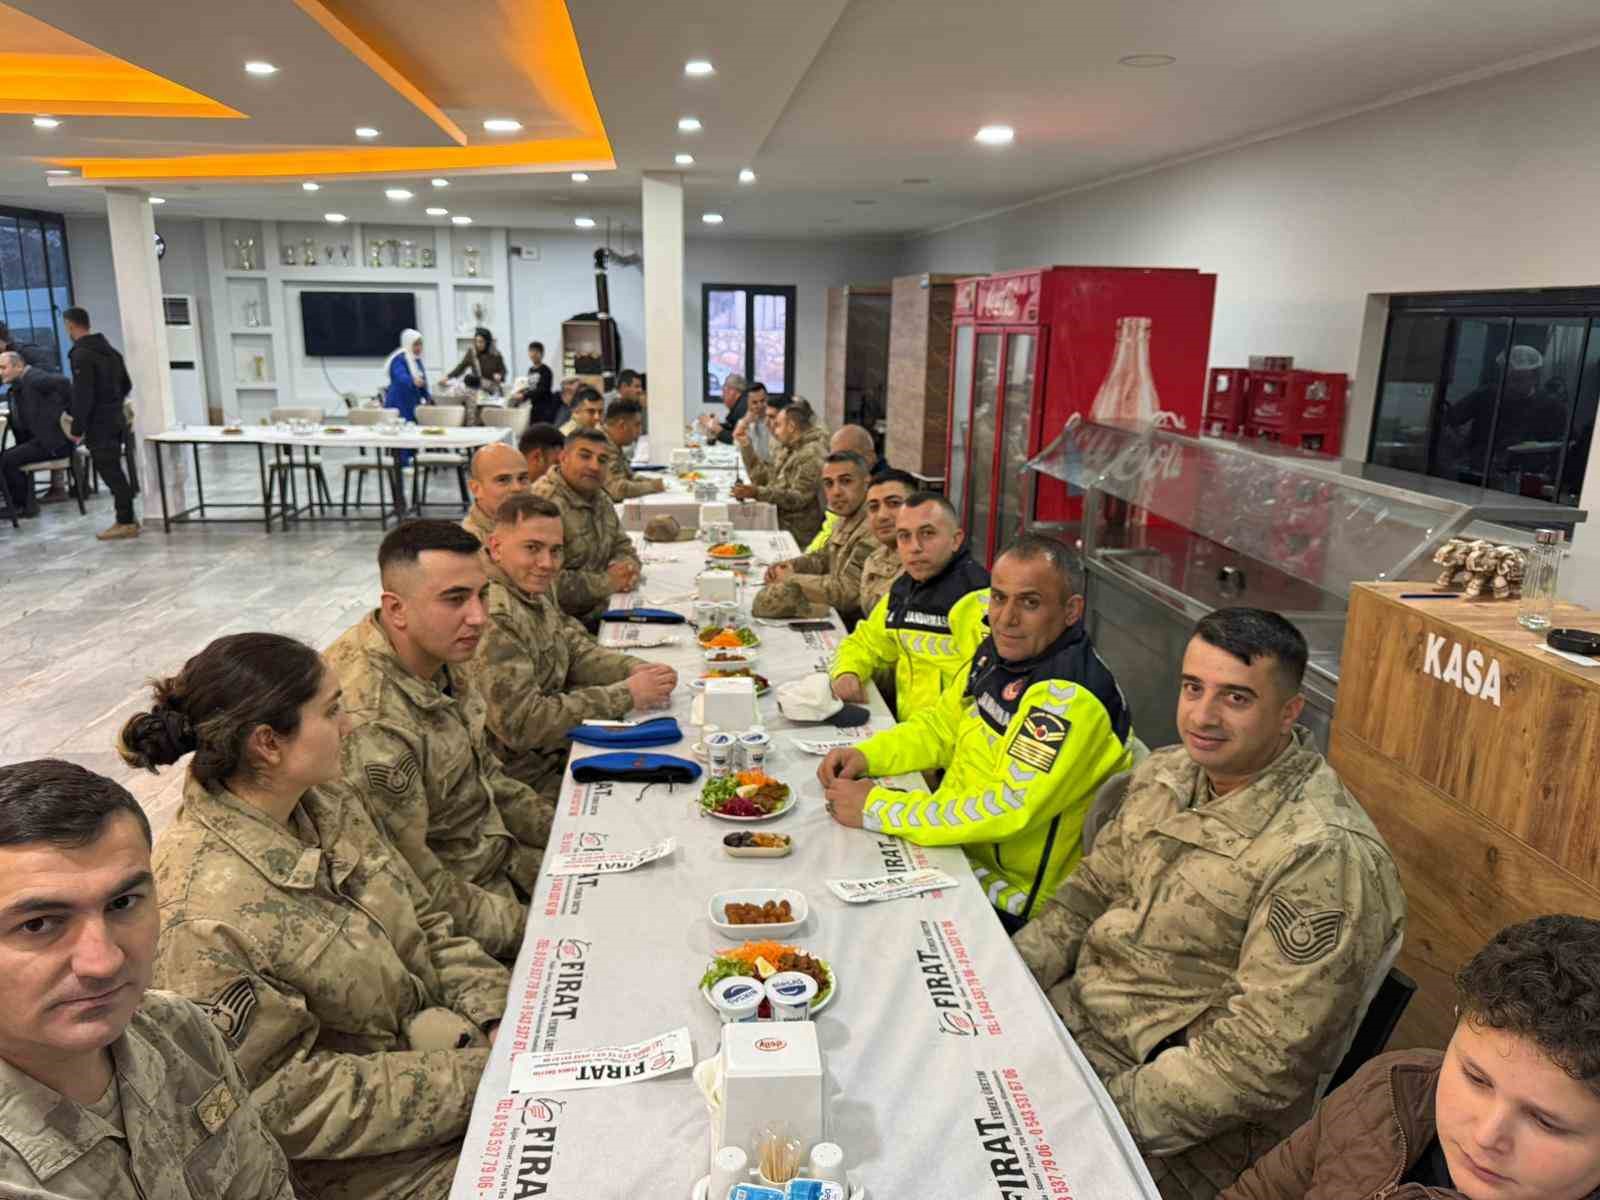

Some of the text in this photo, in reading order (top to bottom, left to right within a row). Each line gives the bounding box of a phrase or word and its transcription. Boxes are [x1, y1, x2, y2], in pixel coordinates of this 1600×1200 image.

[1423, 631, 1501, 707] KASA
[878, 840, 907, 872] IRAT
[916, 950, 960, 1008] FIRAT
[551, 961, 586, 1020] FIRAT
[576, 1061, 645, 1081] FIRAT
[497, 1098, 513, 1112] TEL:
[986, 1096, 1002, 1120] YEMEK
[1012, 1093, 1031, 1109] 537
[1020, 1110, 1040, 1128] 543
[485, 1140, 502, 1157] 537
[1036, 1144, 1052, 1157] 06
[481, 1160, 498, 1172] 79
[514, 1126, 556, 1200] FIRA
[1041, 1160, 1059, 1172] 79
[478, 1176, 494, 1188] 06
[1048, 1175, 1068, 1194] 537
